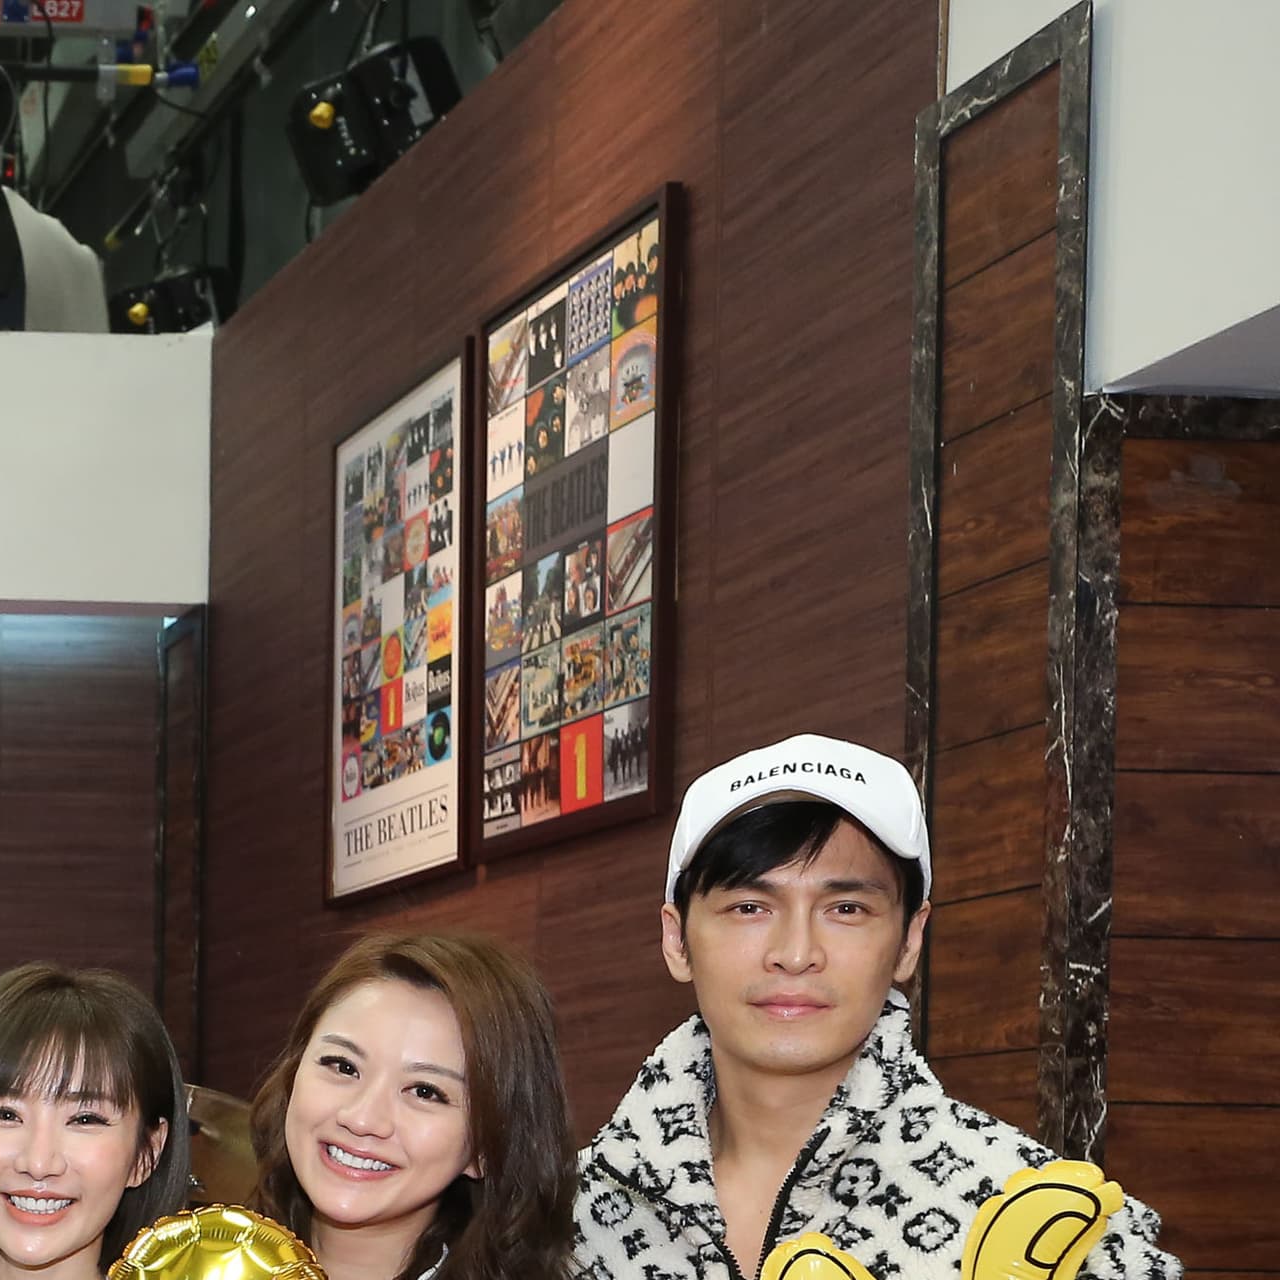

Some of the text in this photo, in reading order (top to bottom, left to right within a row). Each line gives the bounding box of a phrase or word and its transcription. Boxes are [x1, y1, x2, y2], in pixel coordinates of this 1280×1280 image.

[730, 762, 867, 793] BALENCIAGA
[344, 822, 373, 857] THE
[378, 794, 448, 845] BEATLES
